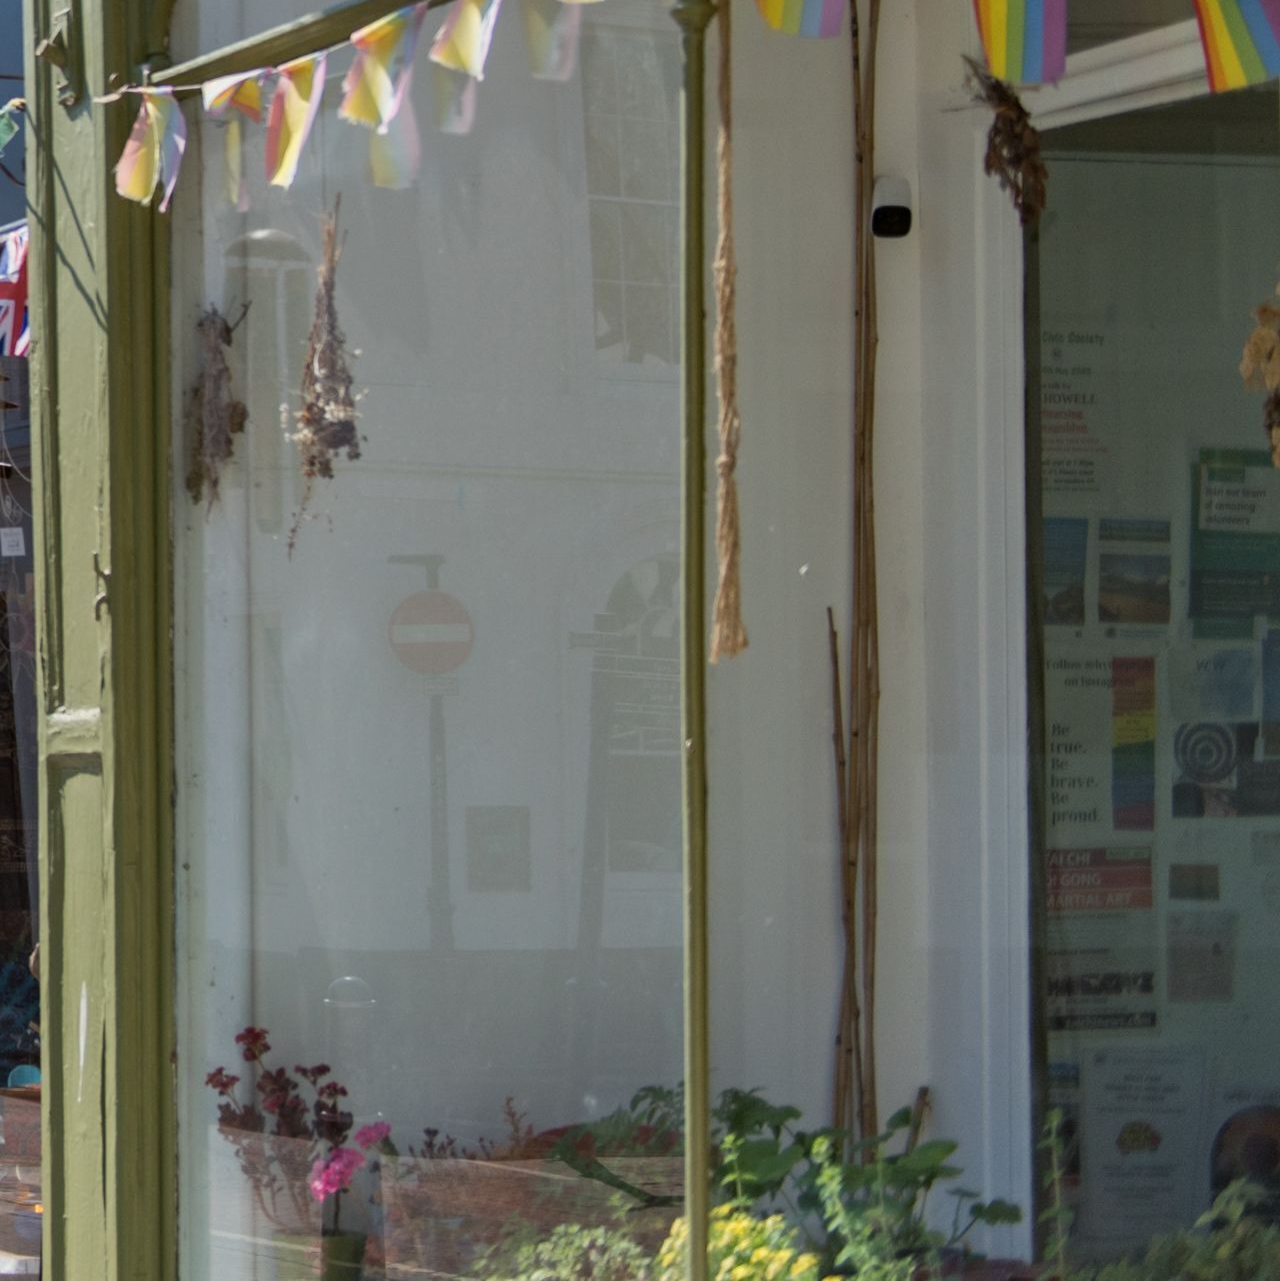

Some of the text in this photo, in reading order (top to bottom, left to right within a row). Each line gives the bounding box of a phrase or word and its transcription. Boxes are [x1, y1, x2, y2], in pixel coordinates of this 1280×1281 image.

[1051, 724, 1070, 736] Be
[1051, 759, 1069, 770] Be
[1051, 792, 1069, 804] Be
[1060, 872, 1101, 887] GONG
[1106, 892, 1133, 907] ART
